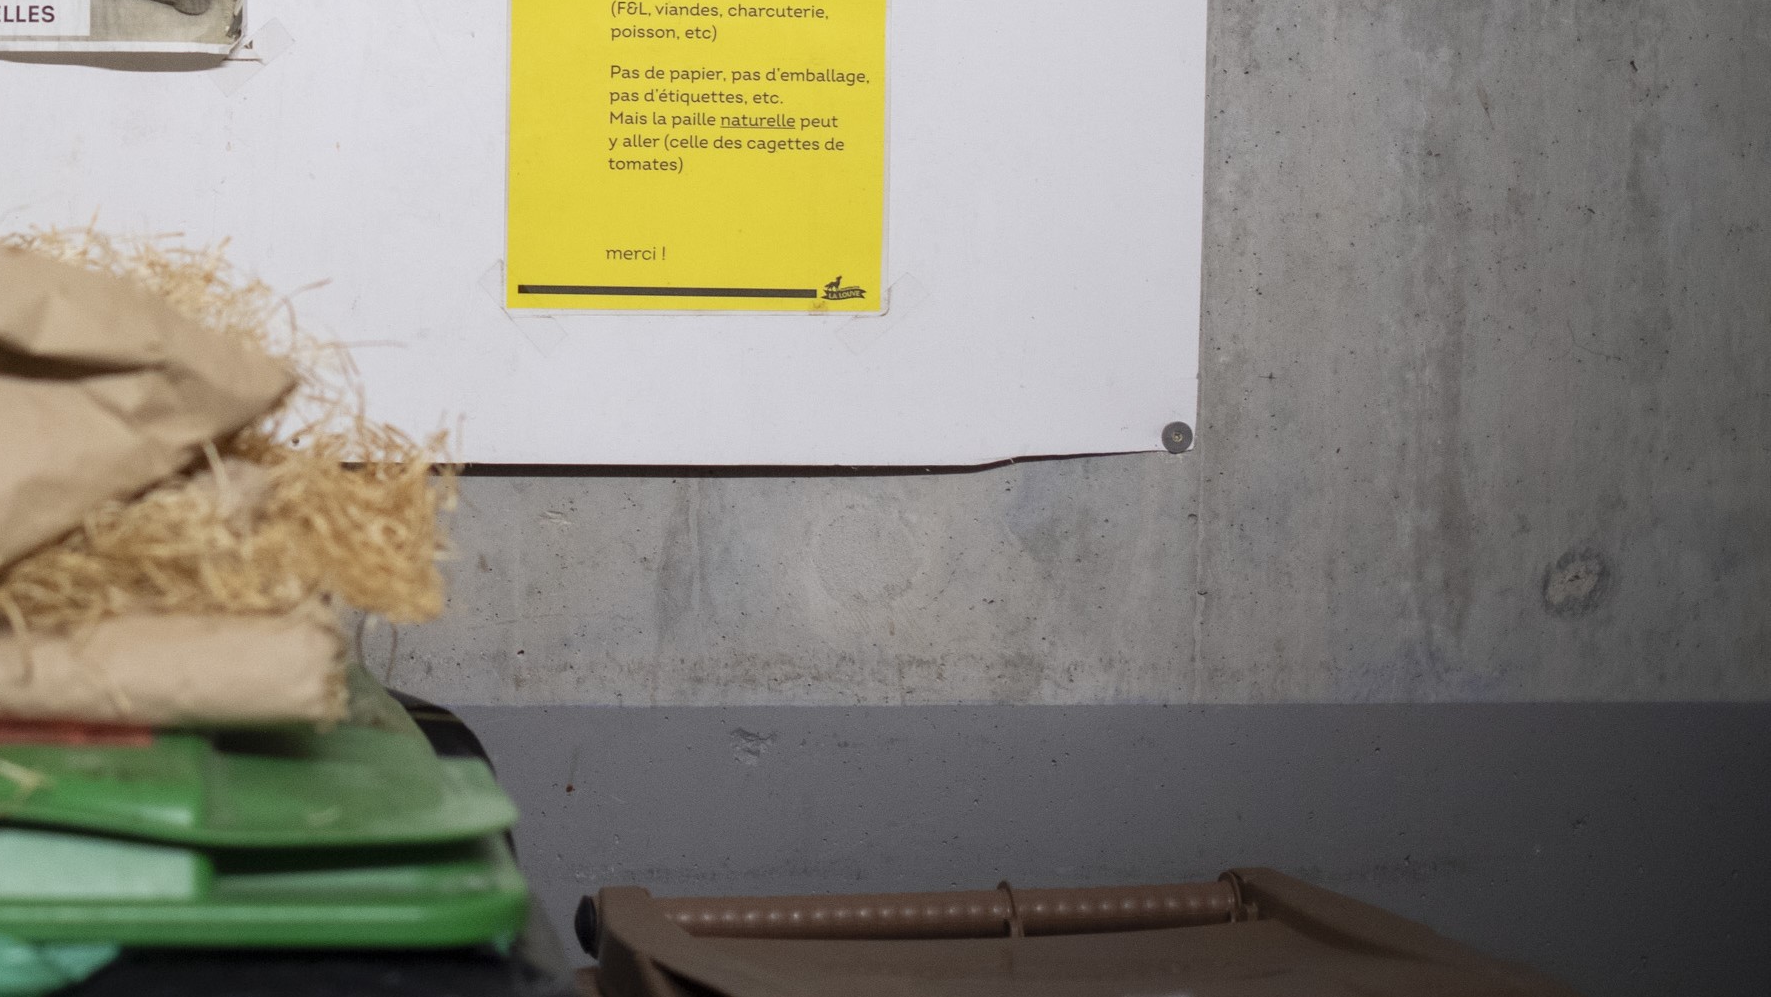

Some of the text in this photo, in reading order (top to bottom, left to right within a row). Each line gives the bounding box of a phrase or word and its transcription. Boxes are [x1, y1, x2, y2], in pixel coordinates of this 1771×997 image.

[612, 1, 828, 19] (F&L, viandes, charcuterie,
[611, 25, 716, 42] poisson, etc)
[611, 65, 869, 86] Pas de papier, pas d'emballage,
[610, 92, 639, 104] pas
[753, 92, 783, 104] etc.
[610, 112, 838, 130] Mais la paille naturelle peut
[609, 134, 844, 153] y aller (celle des cagettes de
[608, 157, 683, 173] tomates)
[606, 247, 655, 260] merci
